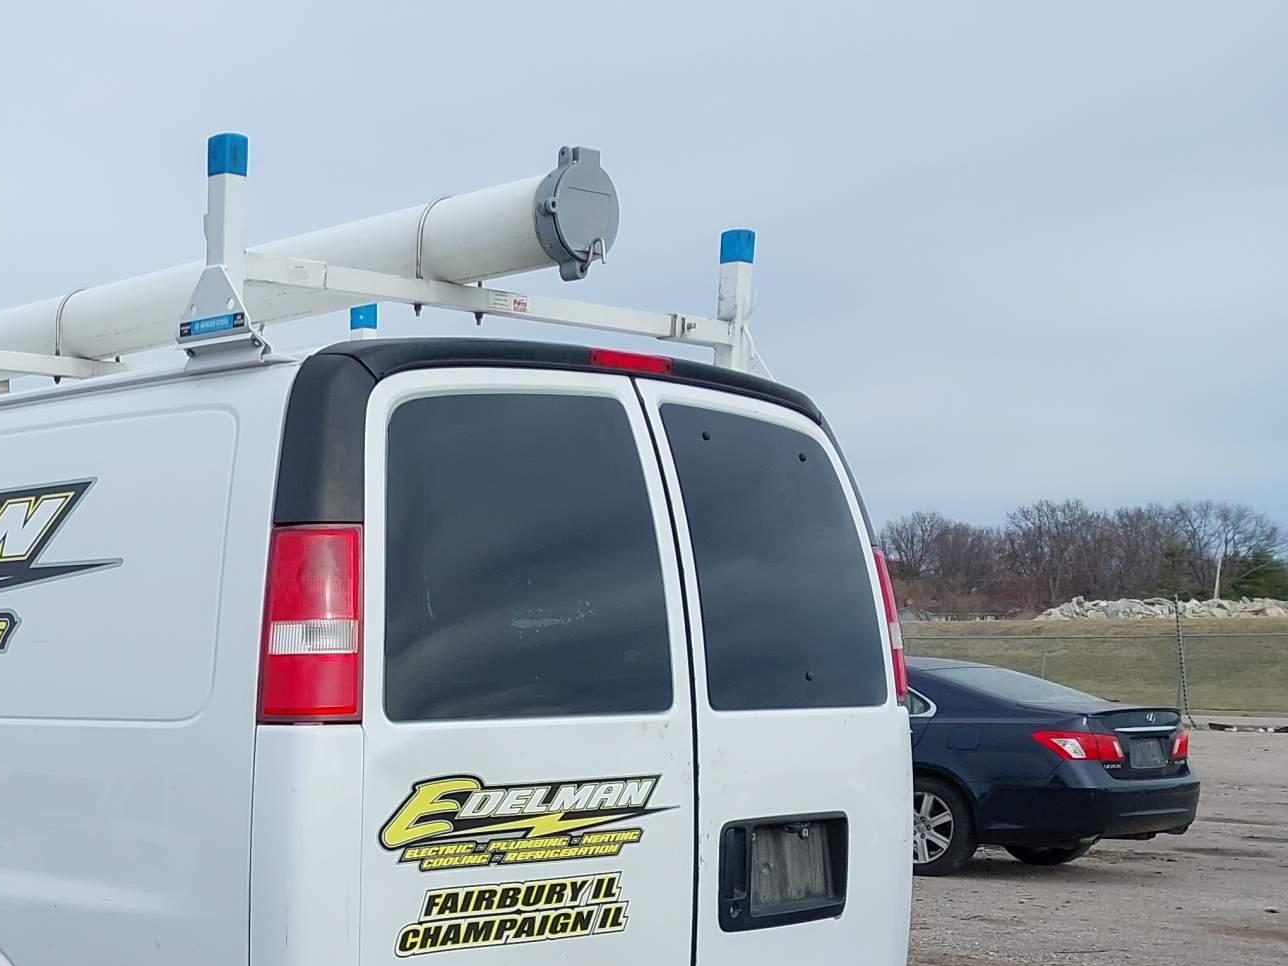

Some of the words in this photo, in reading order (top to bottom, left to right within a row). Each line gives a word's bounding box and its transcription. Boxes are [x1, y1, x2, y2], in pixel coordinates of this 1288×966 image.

[383, 777, 654, 848] EDELMAN
[405, 843, 474, 859] ELECTRIC
[487, 837, 569, 852] PLUMBING
[582, 831, 640, 844] HEATING
[422, 854, 489, 869] COOLING
[504, 844, 620, 862] REFRIGERATION
[423, 879, 590, 917] FAIRBURY
[592, 877, 618, 900] IL
[398, 909, 593, 952] CHAMPAIGN
[597, 906, 624, 928] IL
